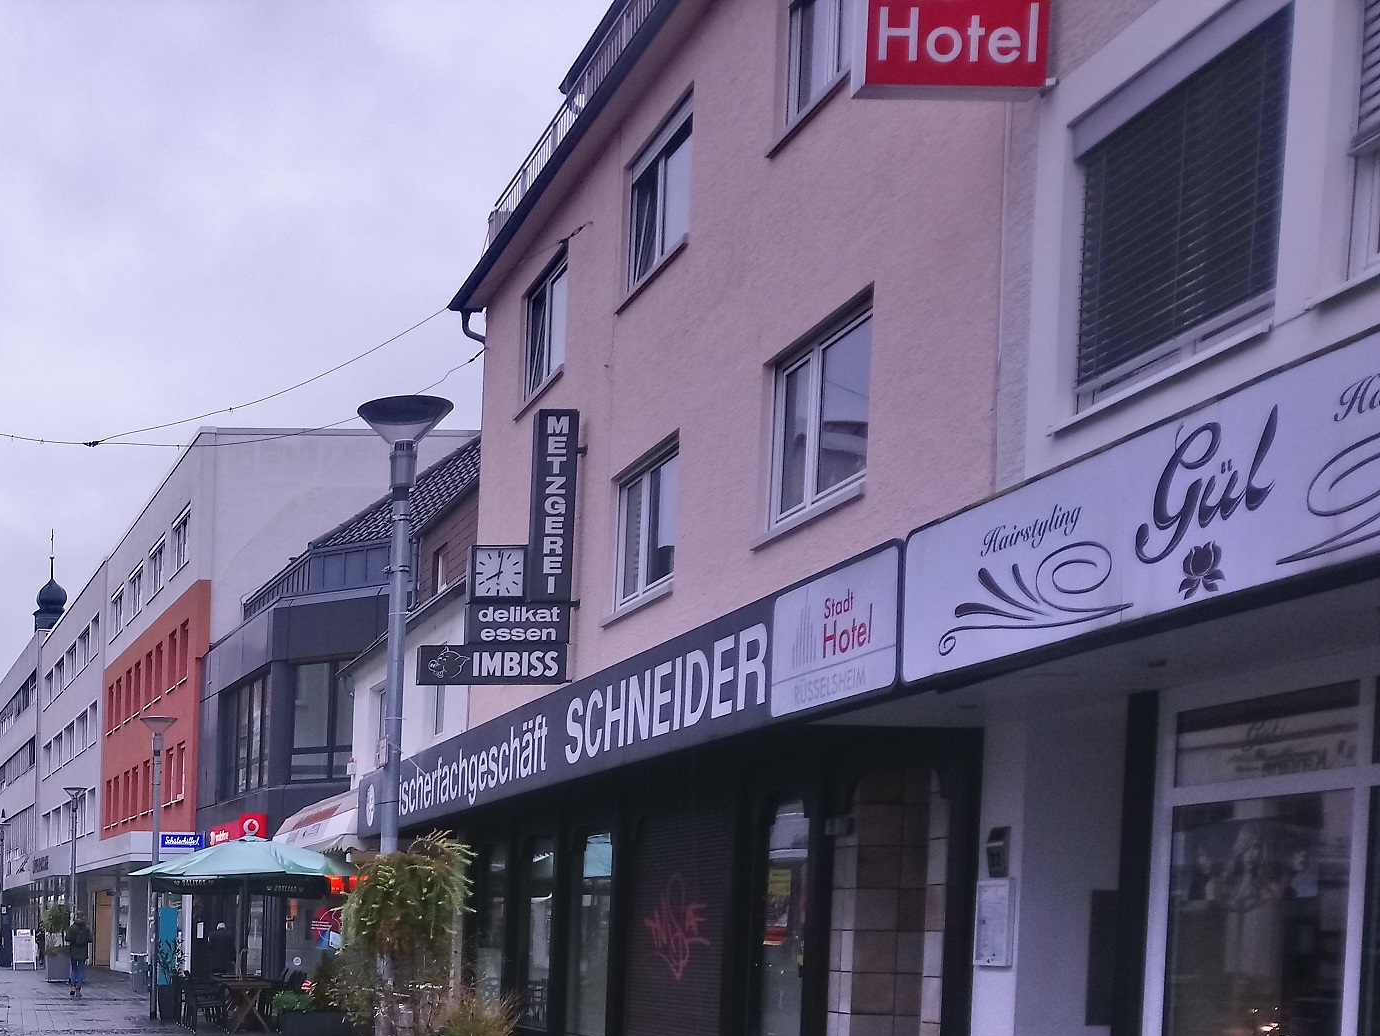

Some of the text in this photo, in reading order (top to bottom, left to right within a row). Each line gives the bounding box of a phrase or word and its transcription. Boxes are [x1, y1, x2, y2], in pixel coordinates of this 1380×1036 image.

[878, 3, 1039, 63] Hotel
[542, 416, 570, 594] METZGEREI
[1135, 404, 1278, 564] Gül
[980, 503, 1083, 557] Hairstyling
[478, 606, 560, 623] delikat
[822, 602, 873, 659] Hotel
[824, 588, 855, 619] Stadt
[480, 627, 557, 642] essen
[472, 651, 559, 677] IMBISS
[794, 665, 866, 706] RÜSSELSHEIM
[564, 622, 768, 765] SCHNEIDER
[399, 713, 548, 816] ischerfachgeschäft
